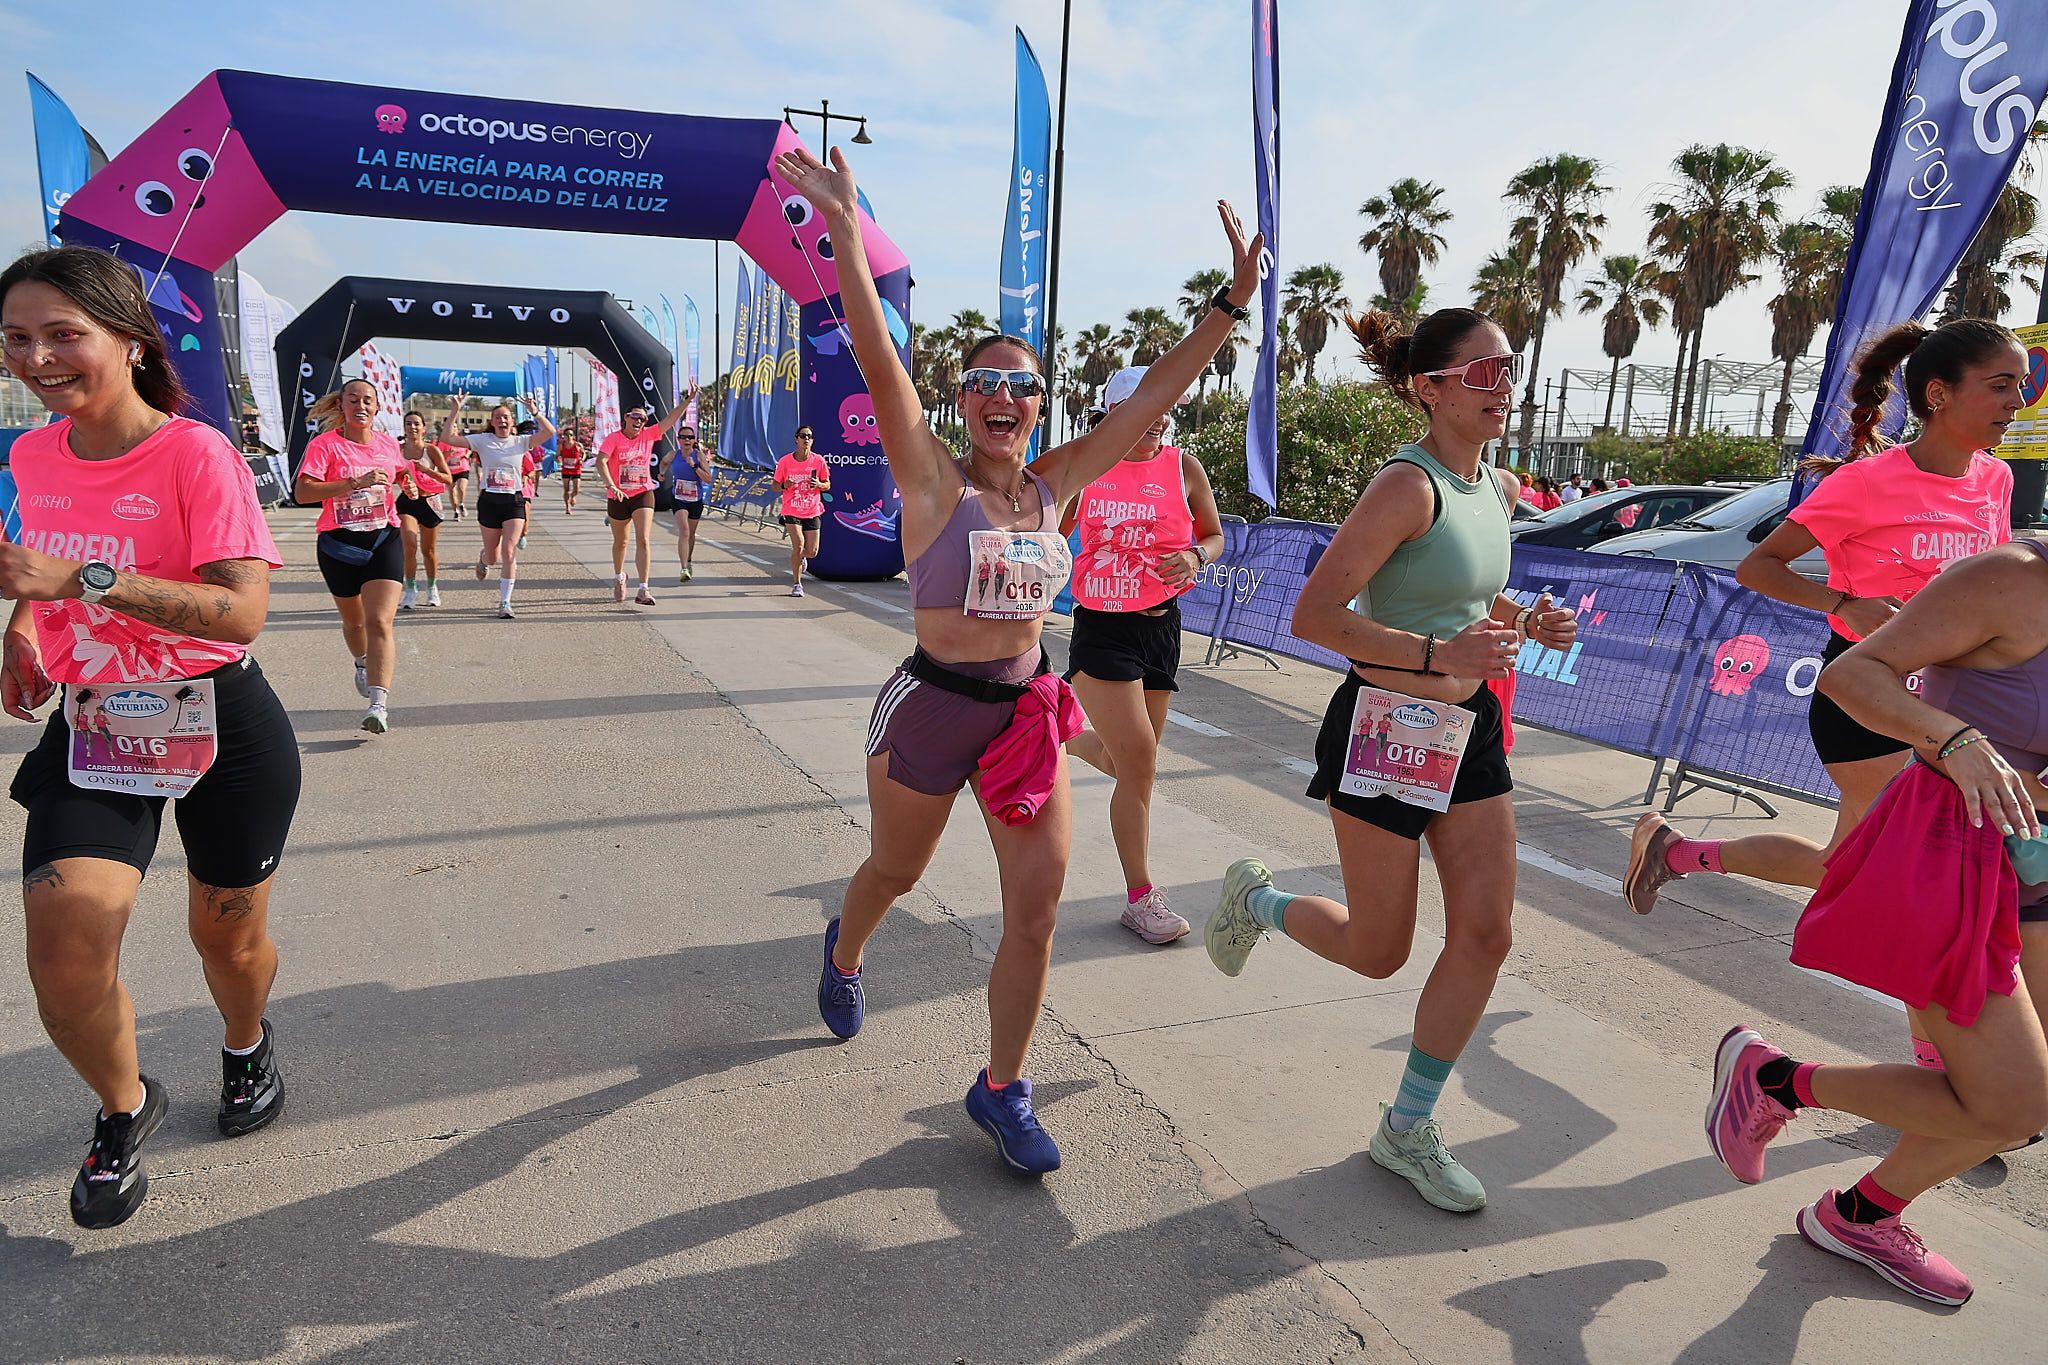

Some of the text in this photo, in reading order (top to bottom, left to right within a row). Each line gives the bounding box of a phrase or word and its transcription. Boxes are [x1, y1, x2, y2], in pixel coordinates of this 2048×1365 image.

[1925, 0, 2035, 155] pus
[419, 112, 653, 160] octopus energy
[356, 147, 664, 190] LA ENERGÍA PARA CORRER
[355, 173, 669, 213] A LA VELOCIDAD DE LA LUZ
[387, 297, 571, 324] VOLVO
[823, 453, 889, 467] topus ene
[340, 466, 384, 478] CARR
[30, 494, 72, 510] OYSHO
[115, 502, 155, 516] ASTURIANA
[352, 506, 373, 515] 016
[1087, 498, 1157, 521] CARRERA
[1904, 510, 1949, 523] OYSHO
[981, 540, 1002, 548] SUMA
[1006, 581, 1043, 600] 016
[1085, 578, 1141, 599] MUJER
[1015, 603, 1034, 611] 4036
[1102, 600, 1123, 612] 2026
[977, 611, 1005, 619] CARRERA
[1515, 638, 1583, 686] NAL
[108, 700, 164, 712] ASTURIANA
[1368, 698, 1392, 709] SUMA
[1395, 709, 1436, 726] ASTURIANA
[117, 735, 168, 756] 016
[1386, 743, 1427, 766] 016
[86, 764, 122, 772] CARRERA
[172, 768, 202, 777] VALENCIA
[1355, 767, 1382, 779] CARRERA
[1396, 766, 1415, 777] 1963
[88, 775, 137, 787] OYSHO
[165, 781, 192, 791] Santand
[1404, 789, 1436, 803] Santander
